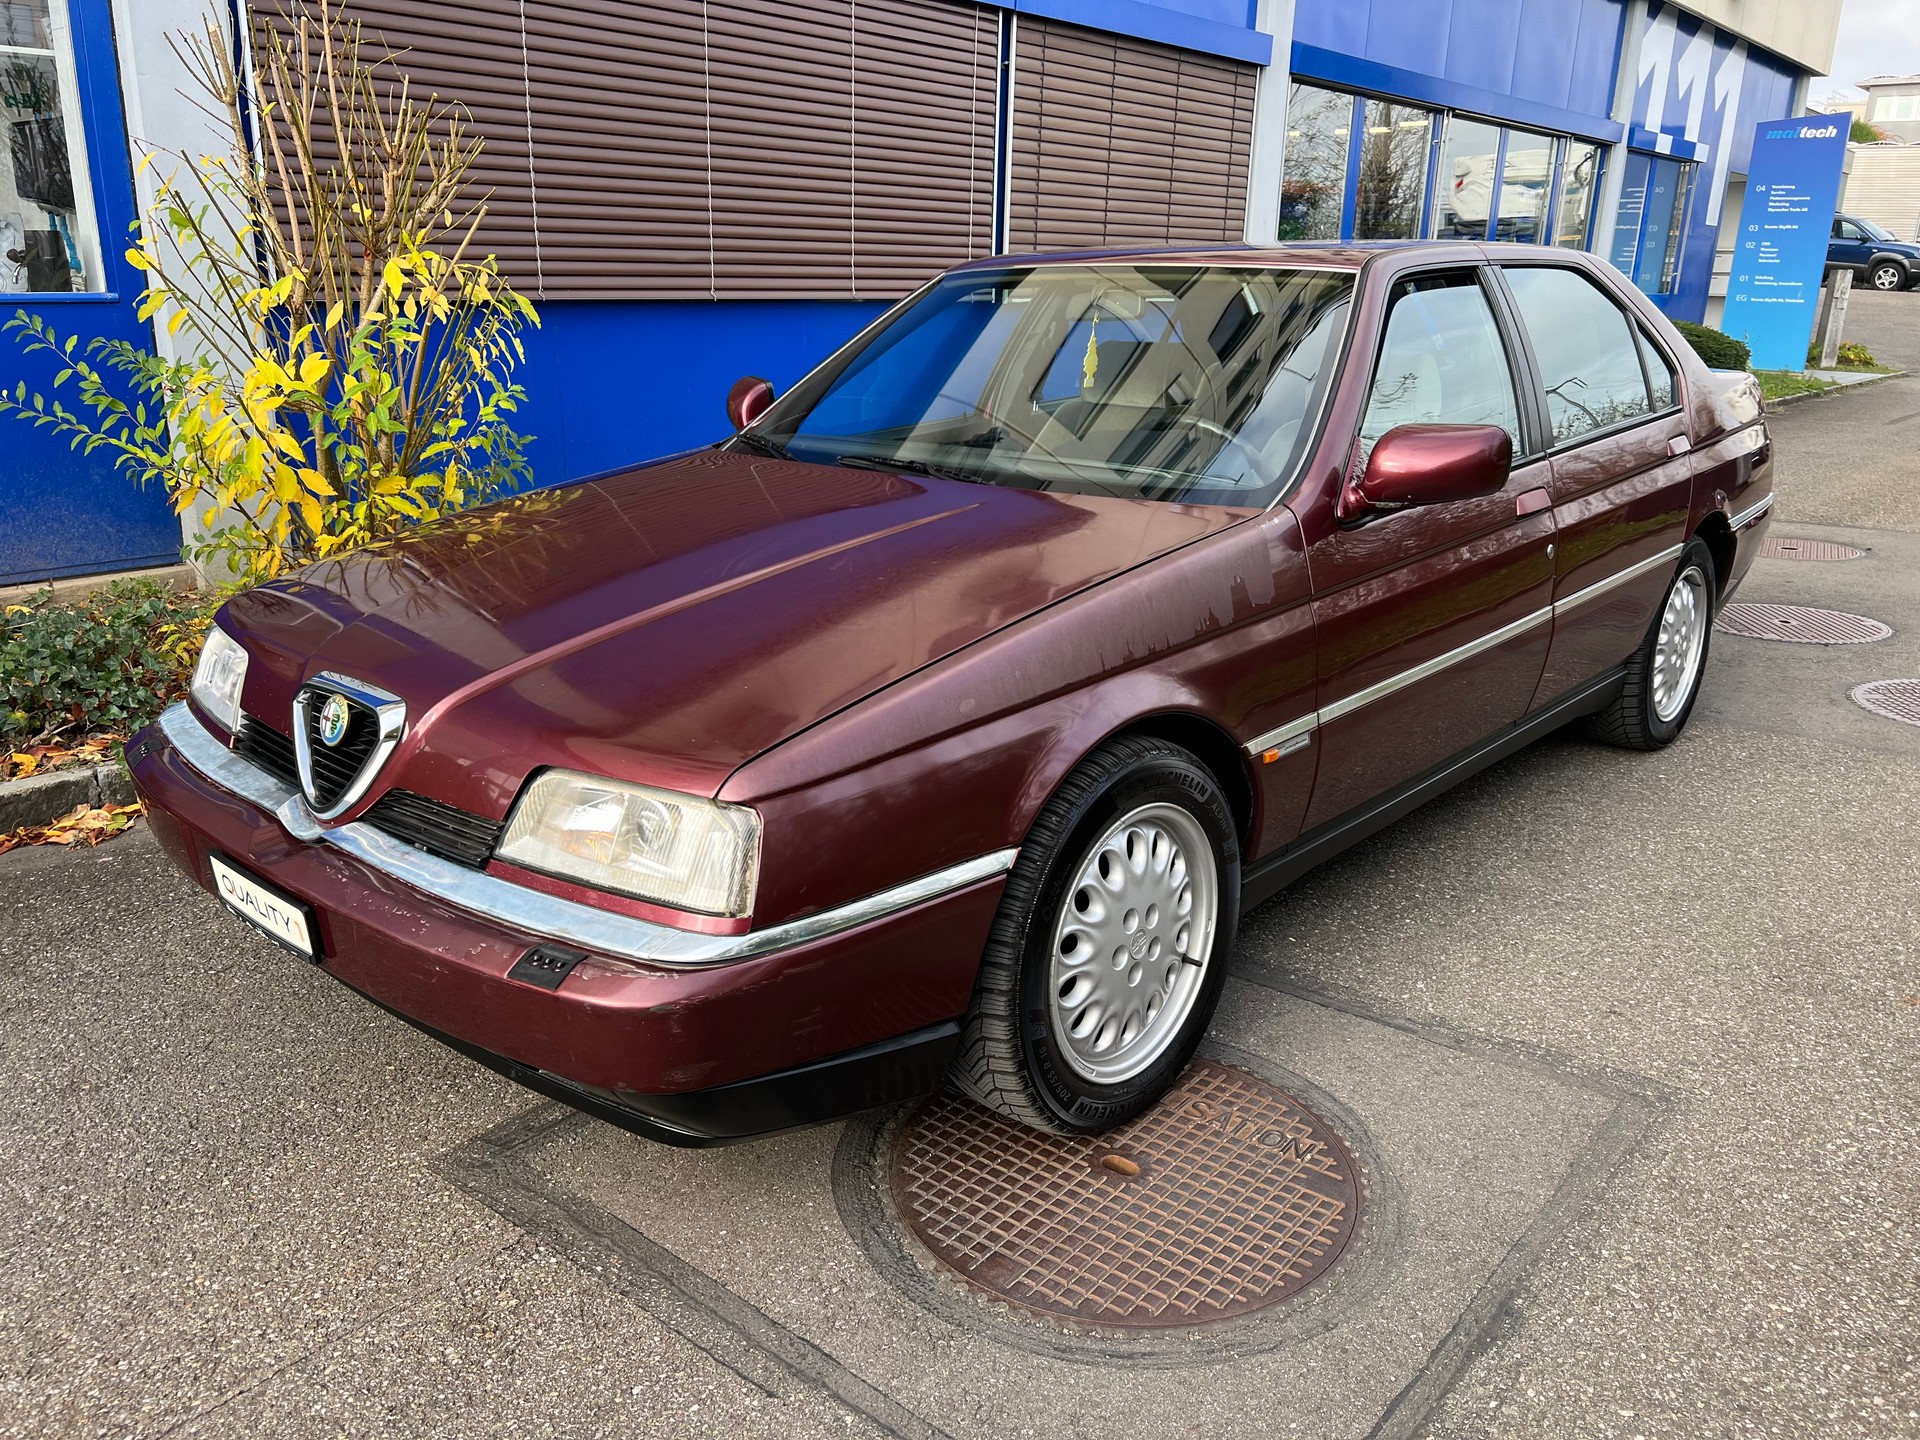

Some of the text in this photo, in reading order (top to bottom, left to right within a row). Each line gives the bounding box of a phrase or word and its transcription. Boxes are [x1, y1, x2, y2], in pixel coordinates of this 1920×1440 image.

[1766, 125, 1838, 140] maltech
[1755, 184, 1766, 192] 04
[1748, 224, 1759, 232] 03
[1745, 241, 1756, 249] 02
[1739, 274, 1749, 282] 01
[1736, 294, 1747, 302] EG
[1038, 1046, 1072, 1102] 205/55 R 16
